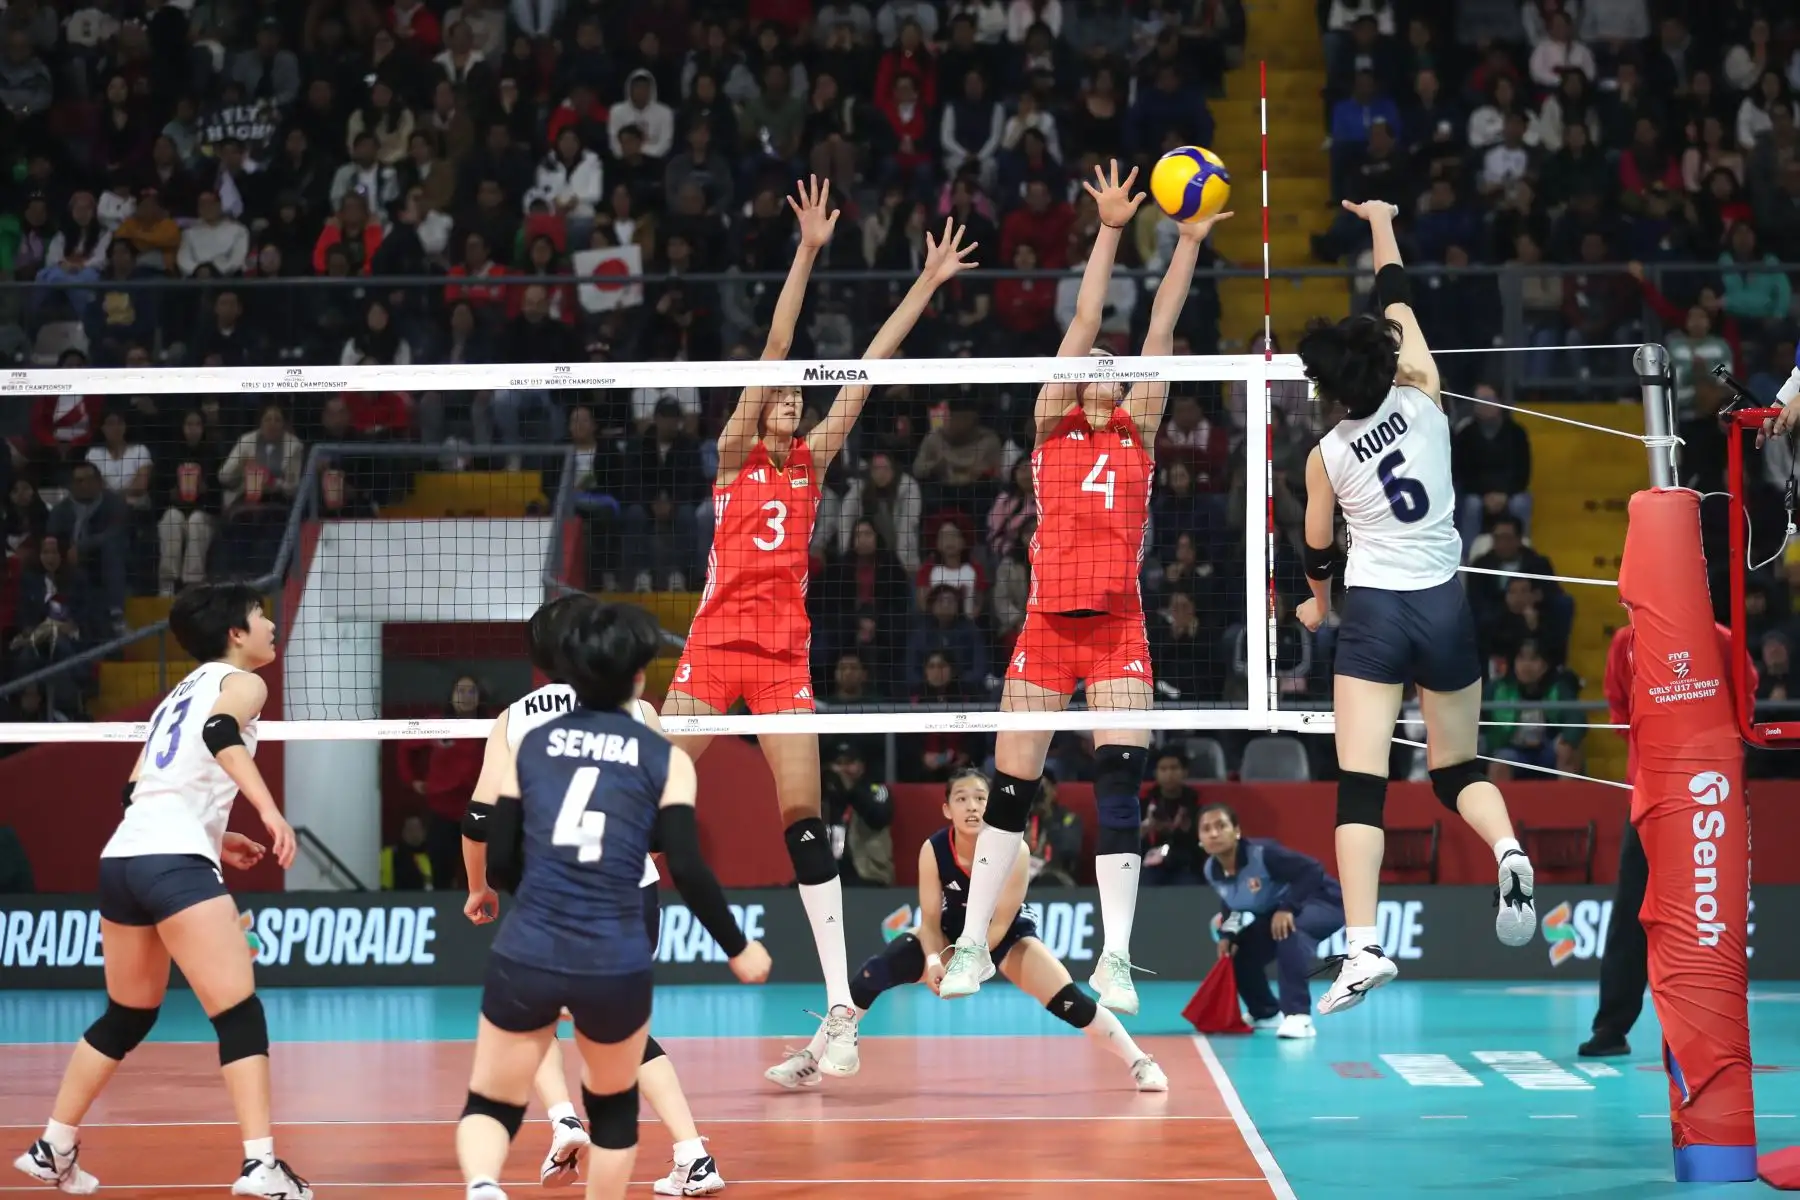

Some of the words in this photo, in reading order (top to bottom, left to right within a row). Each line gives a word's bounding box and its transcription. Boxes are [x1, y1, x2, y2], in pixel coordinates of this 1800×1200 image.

[1349, 412, 1408, 463] KUDO
[1081, 454, 1116, 509] 4
[1376, 448, 1430, 524] 6
[752, 500, 787, 551] 3
[677, 663, 691, 683] 3
[1013, 651, 1026, 673] 4
[1668, 651, 1689, 661] FIVB
[1649, 686, 1672, 696] GIRLS'
[1674, 683, 1690, 693] U17
[1693, 679, 1720, 689] WORLD
[1655, 688, 1716, 704] CHAMPIONSHIP
[144, 695, 193, 769] 13
[546, 728, 639, 767] SEMBA
[552, 766, 606, 863] 4
[1692, 810, 1726, 947] Senoh
[256, 906, 436, 966] SPORADE
